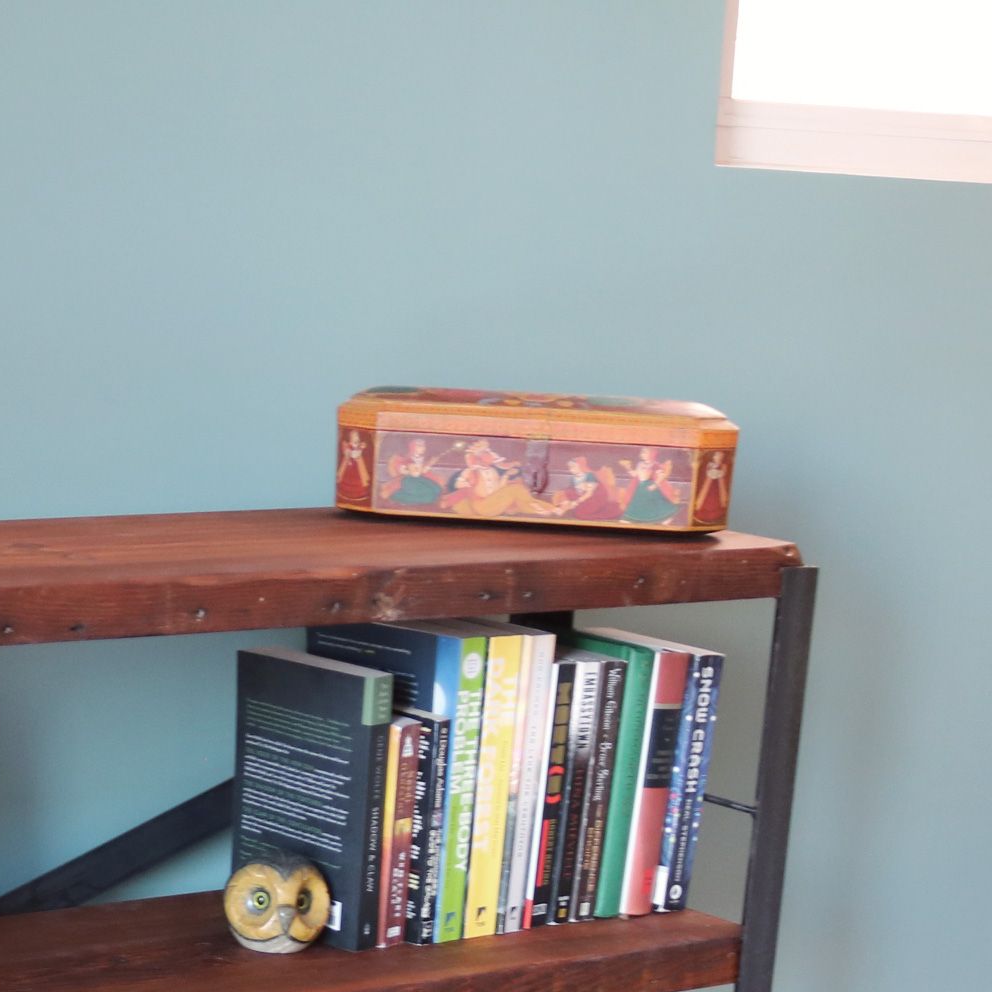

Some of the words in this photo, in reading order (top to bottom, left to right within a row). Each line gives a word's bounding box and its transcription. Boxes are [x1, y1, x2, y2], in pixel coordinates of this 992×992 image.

[482, 656, 506, 740] DARK
[502, 672, 519, 727] THE
[605, 668, 623, 699] William
[694, 665, 715, 723] SNOW
[465, 688, 483, 729] THE
[575, 671, 598, 749] EMBASSYTOWN
[603, 700, 619, 730] Gibson
[436, 739, 448, 777] Douglas
[450, 690, 470, 795] PROBLEM
[597, 741, 613, 769] Bruce
[684, 728, 706, 793] CRASH
[434, 777, 446, 808] Adams
[454, 735, 480, 872] THREE-BODY
[472, 745, 498, 852] FOREST
[591, 768, 610, 801] Sterling
[369, 806, 380, 851] SHADOW
[366, 864, 376, 892] CLAW
